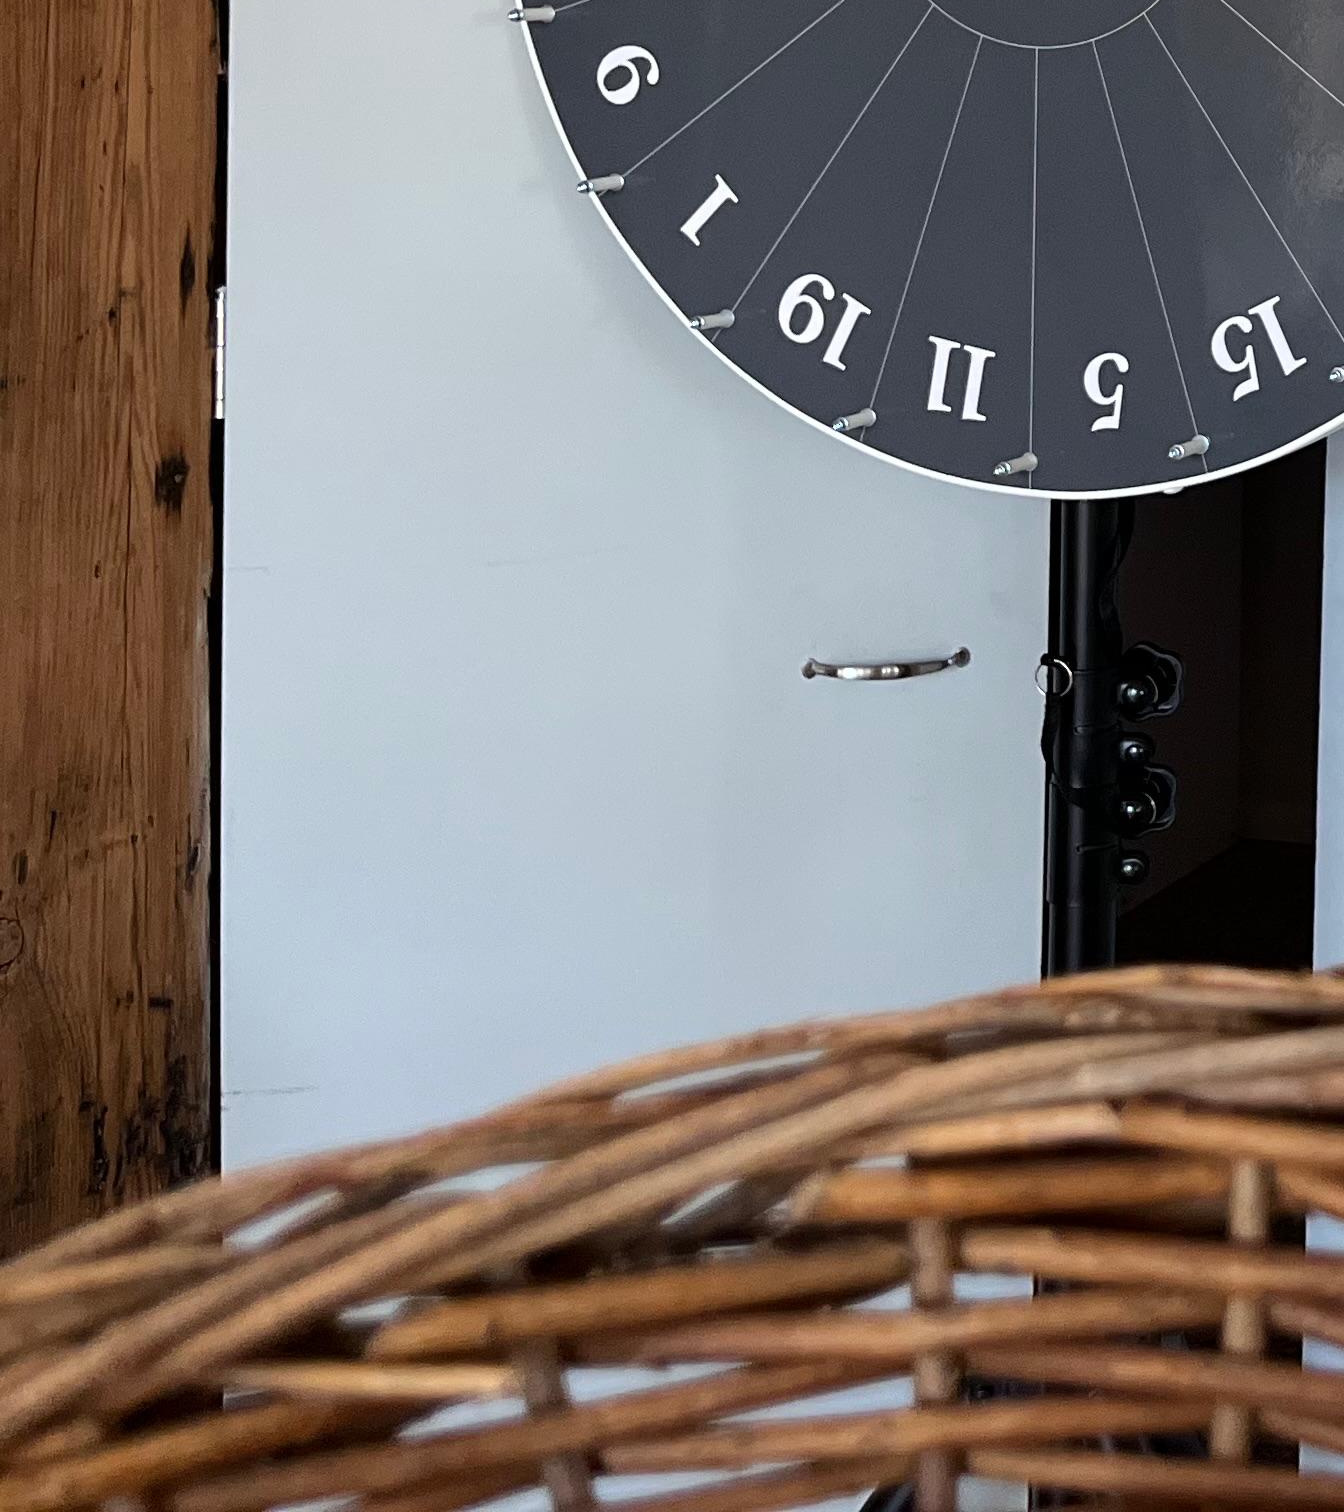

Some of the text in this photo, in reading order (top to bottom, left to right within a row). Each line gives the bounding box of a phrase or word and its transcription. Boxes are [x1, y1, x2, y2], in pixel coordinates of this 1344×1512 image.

[597, 46, 659, 104] 9
[681, 174, 738, 246] 1
[779, 274, 871, 370] 19
[1212, 296, 1306, 401] 15
[927, 336, 995, 421] 11
[1084, 353, 1128, 431] 5
